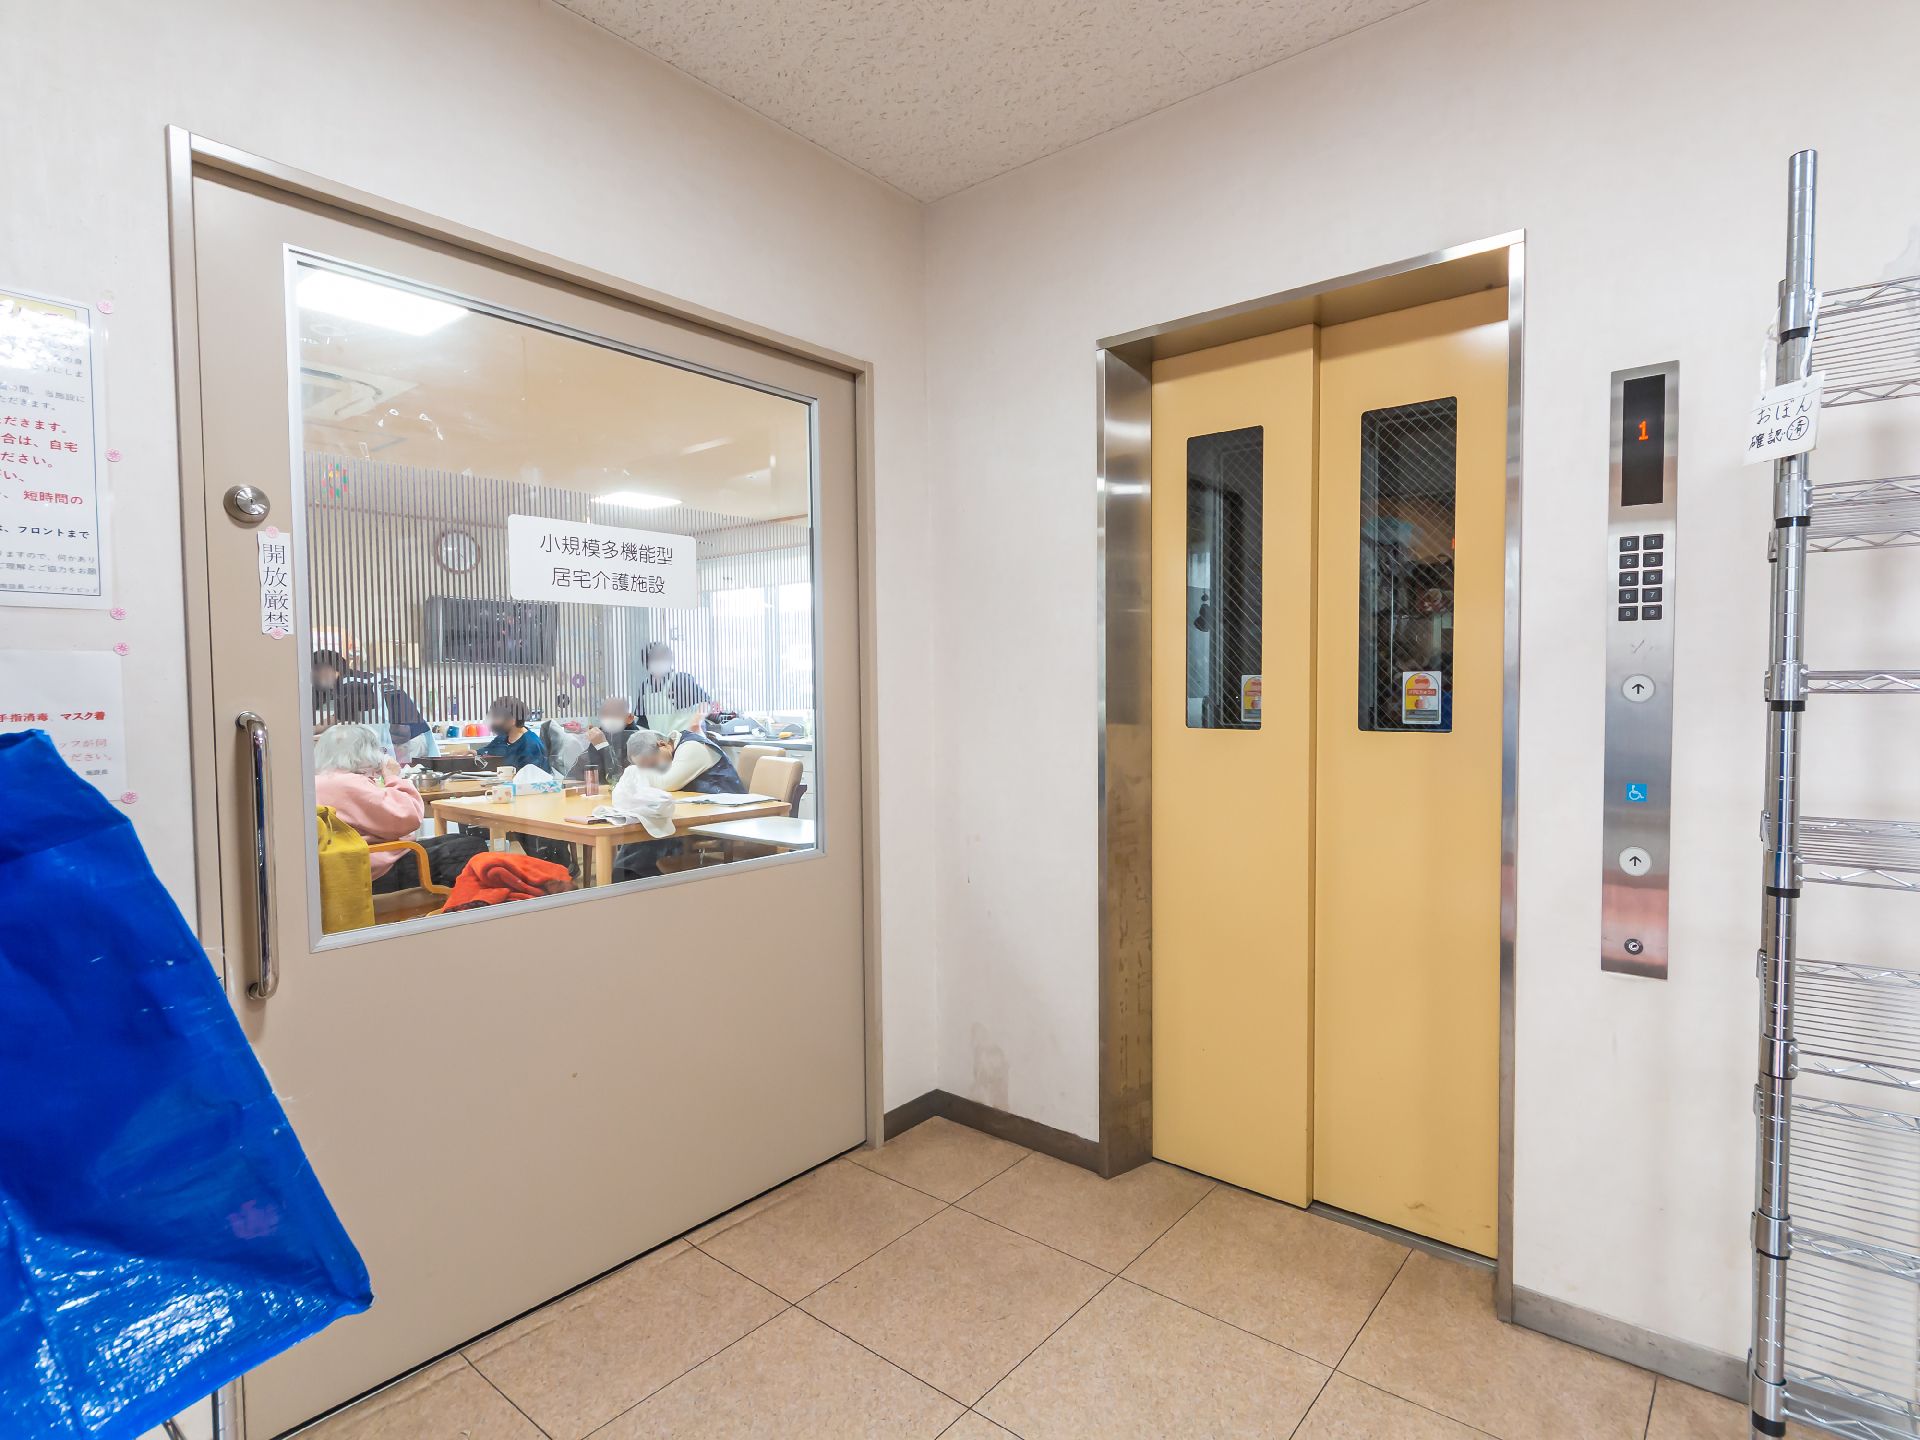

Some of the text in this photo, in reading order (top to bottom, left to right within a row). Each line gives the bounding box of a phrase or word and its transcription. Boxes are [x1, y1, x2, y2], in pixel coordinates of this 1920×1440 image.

[0, 415, 67, 434] だきます。
[1756, 396, 1813, 425] おぼん
[1638, 419, 1649, 441] 1
[539, 533, 673, 566] 小規模多機能型
[262, 543, 289, 632] 開放厳禁
[551, 567, 666, 595] 居宅介護施設
